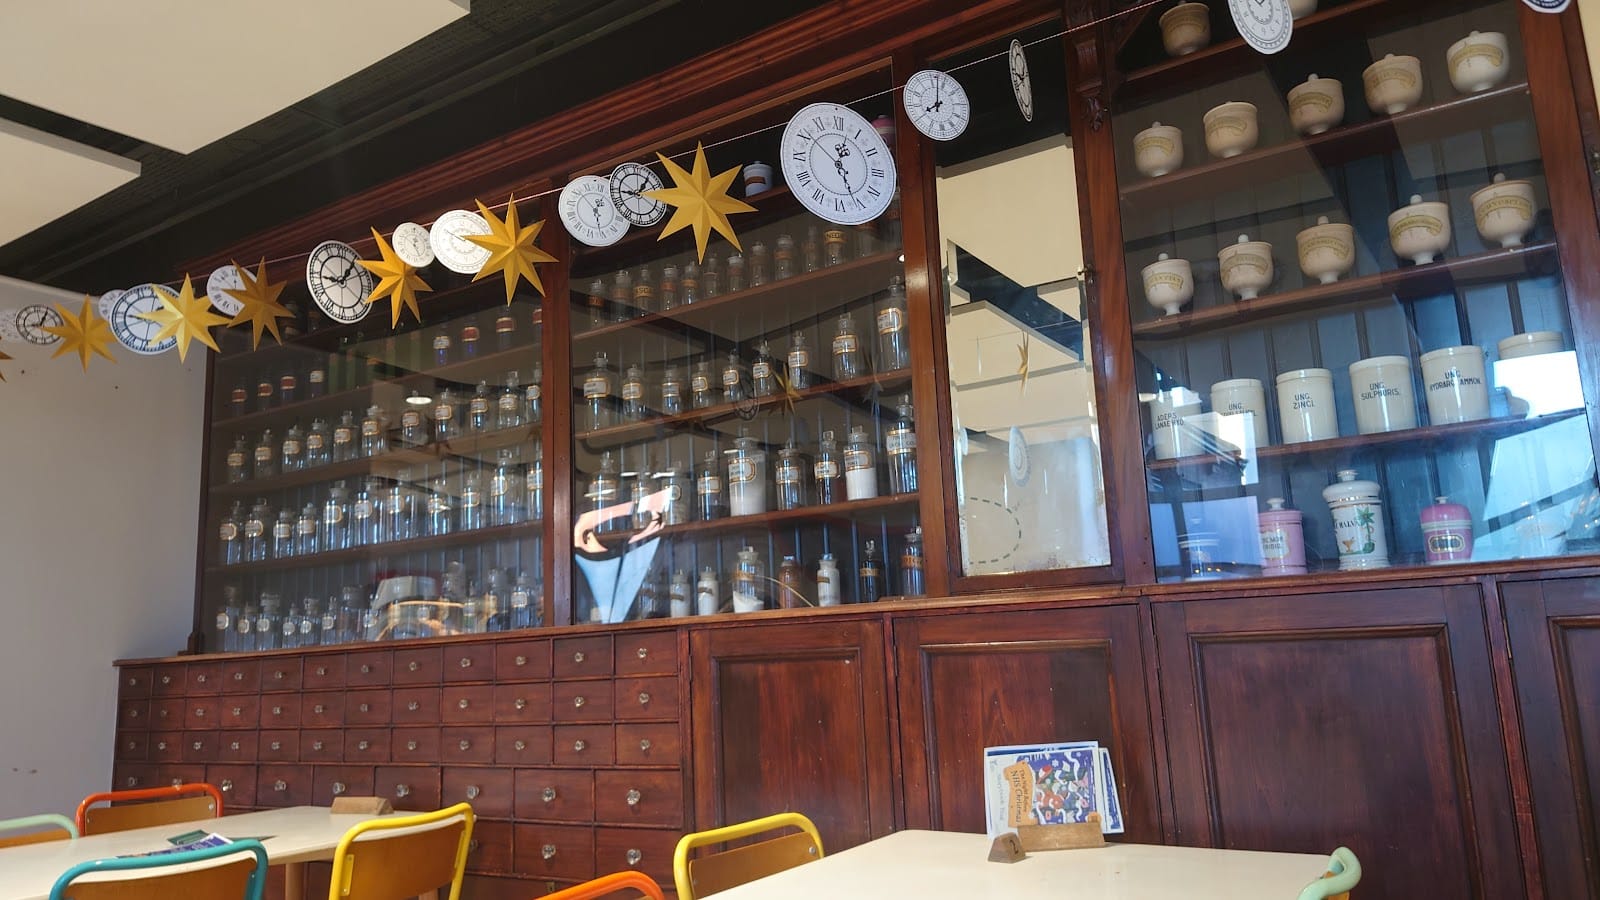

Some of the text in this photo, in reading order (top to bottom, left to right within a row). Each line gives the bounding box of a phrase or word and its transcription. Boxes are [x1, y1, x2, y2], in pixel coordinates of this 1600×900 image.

[812, 117, 825, 132] XI
[833, 115, 844, 131] XII
[793, 149, 806, 162] IX
[865, 147, 878, 157] II
[797, 171, 812, 187] VIII
[871, 168, 885, 178] III
[812, 189, 825, 204] VII
[834, 198, 846, 213] VI
[1010, 770, 1023, 823] NHS Christmas
